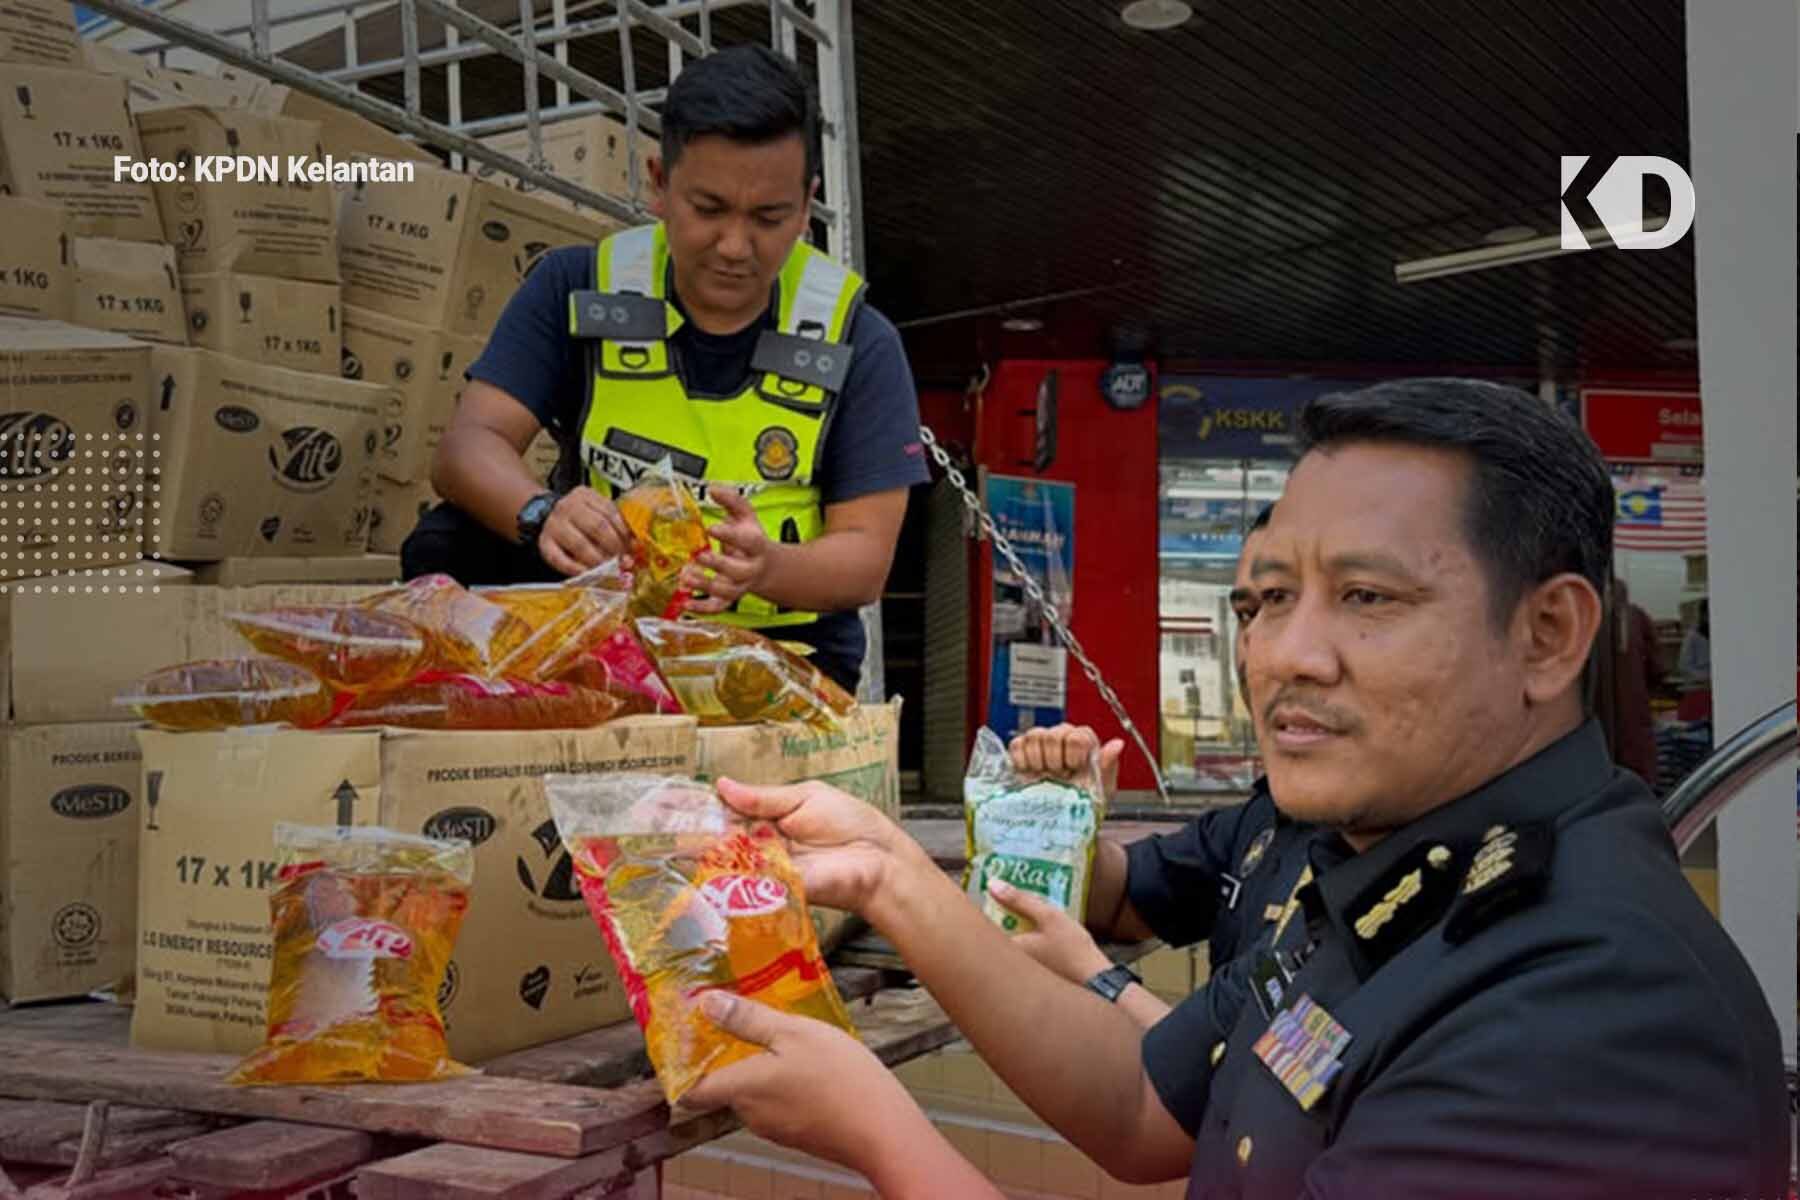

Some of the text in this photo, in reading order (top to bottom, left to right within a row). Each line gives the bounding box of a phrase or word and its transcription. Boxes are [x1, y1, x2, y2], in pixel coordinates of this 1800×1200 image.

[53, 132, 70, 147] 17
[92, 134, 122, 150] 1KG
[368, 215, 384, 229] 17
[400, 221, 429, 239] 1KG
[13, 267, 49, 289] 1KG
[97, 295, 115, 310] 17
[136, 296, 164, 313] 1KG
[1215, 409, 1284, 428] KSKK
[1658, 408, 1700, 425] Sela
[176, 856, 278, 889] 17 x 1K
[159, 933, 203, 952] ENERGY
